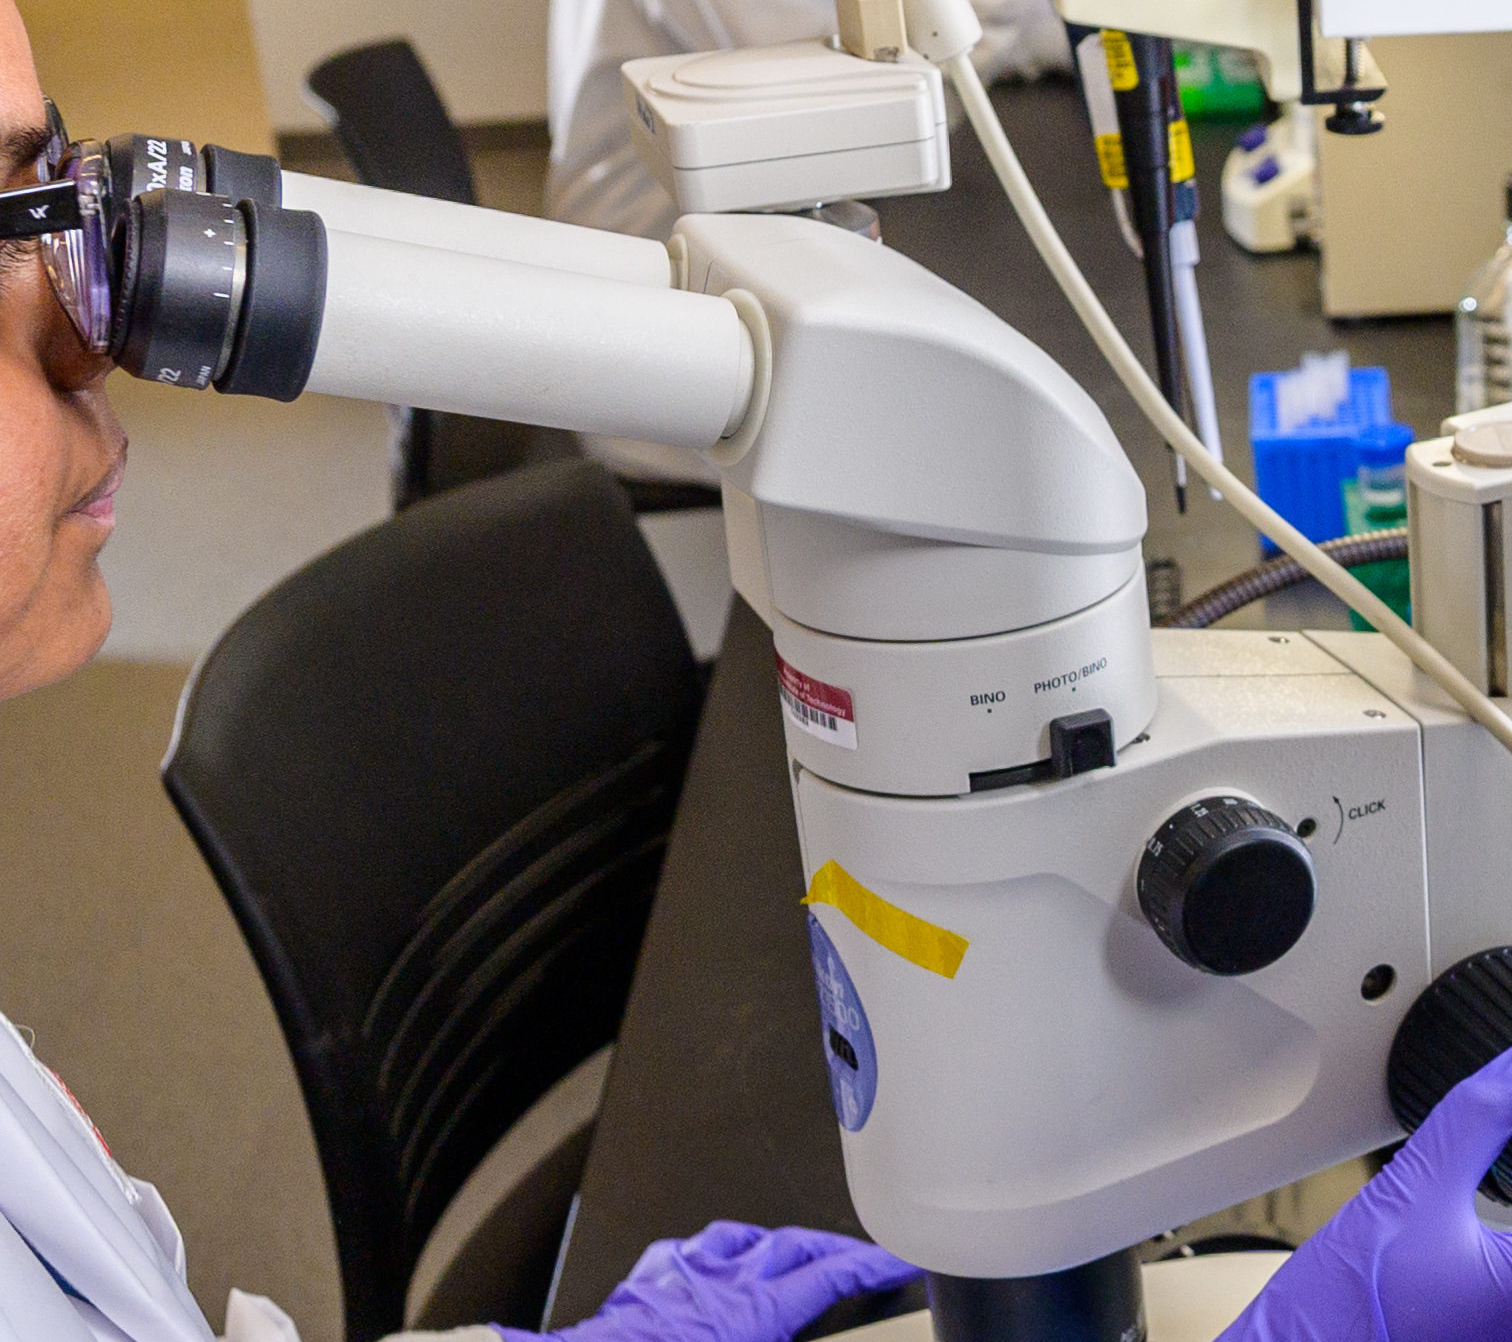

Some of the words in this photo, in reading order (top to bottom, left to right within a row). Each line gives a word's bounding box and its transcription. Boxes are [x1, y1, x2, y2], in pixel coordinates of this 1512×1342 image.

[1033, 656, 1109, 694] PHOTO/BINO
[969, 690, 1007, 707] BINO
[1347, 798, 1387, 821] CLICK
